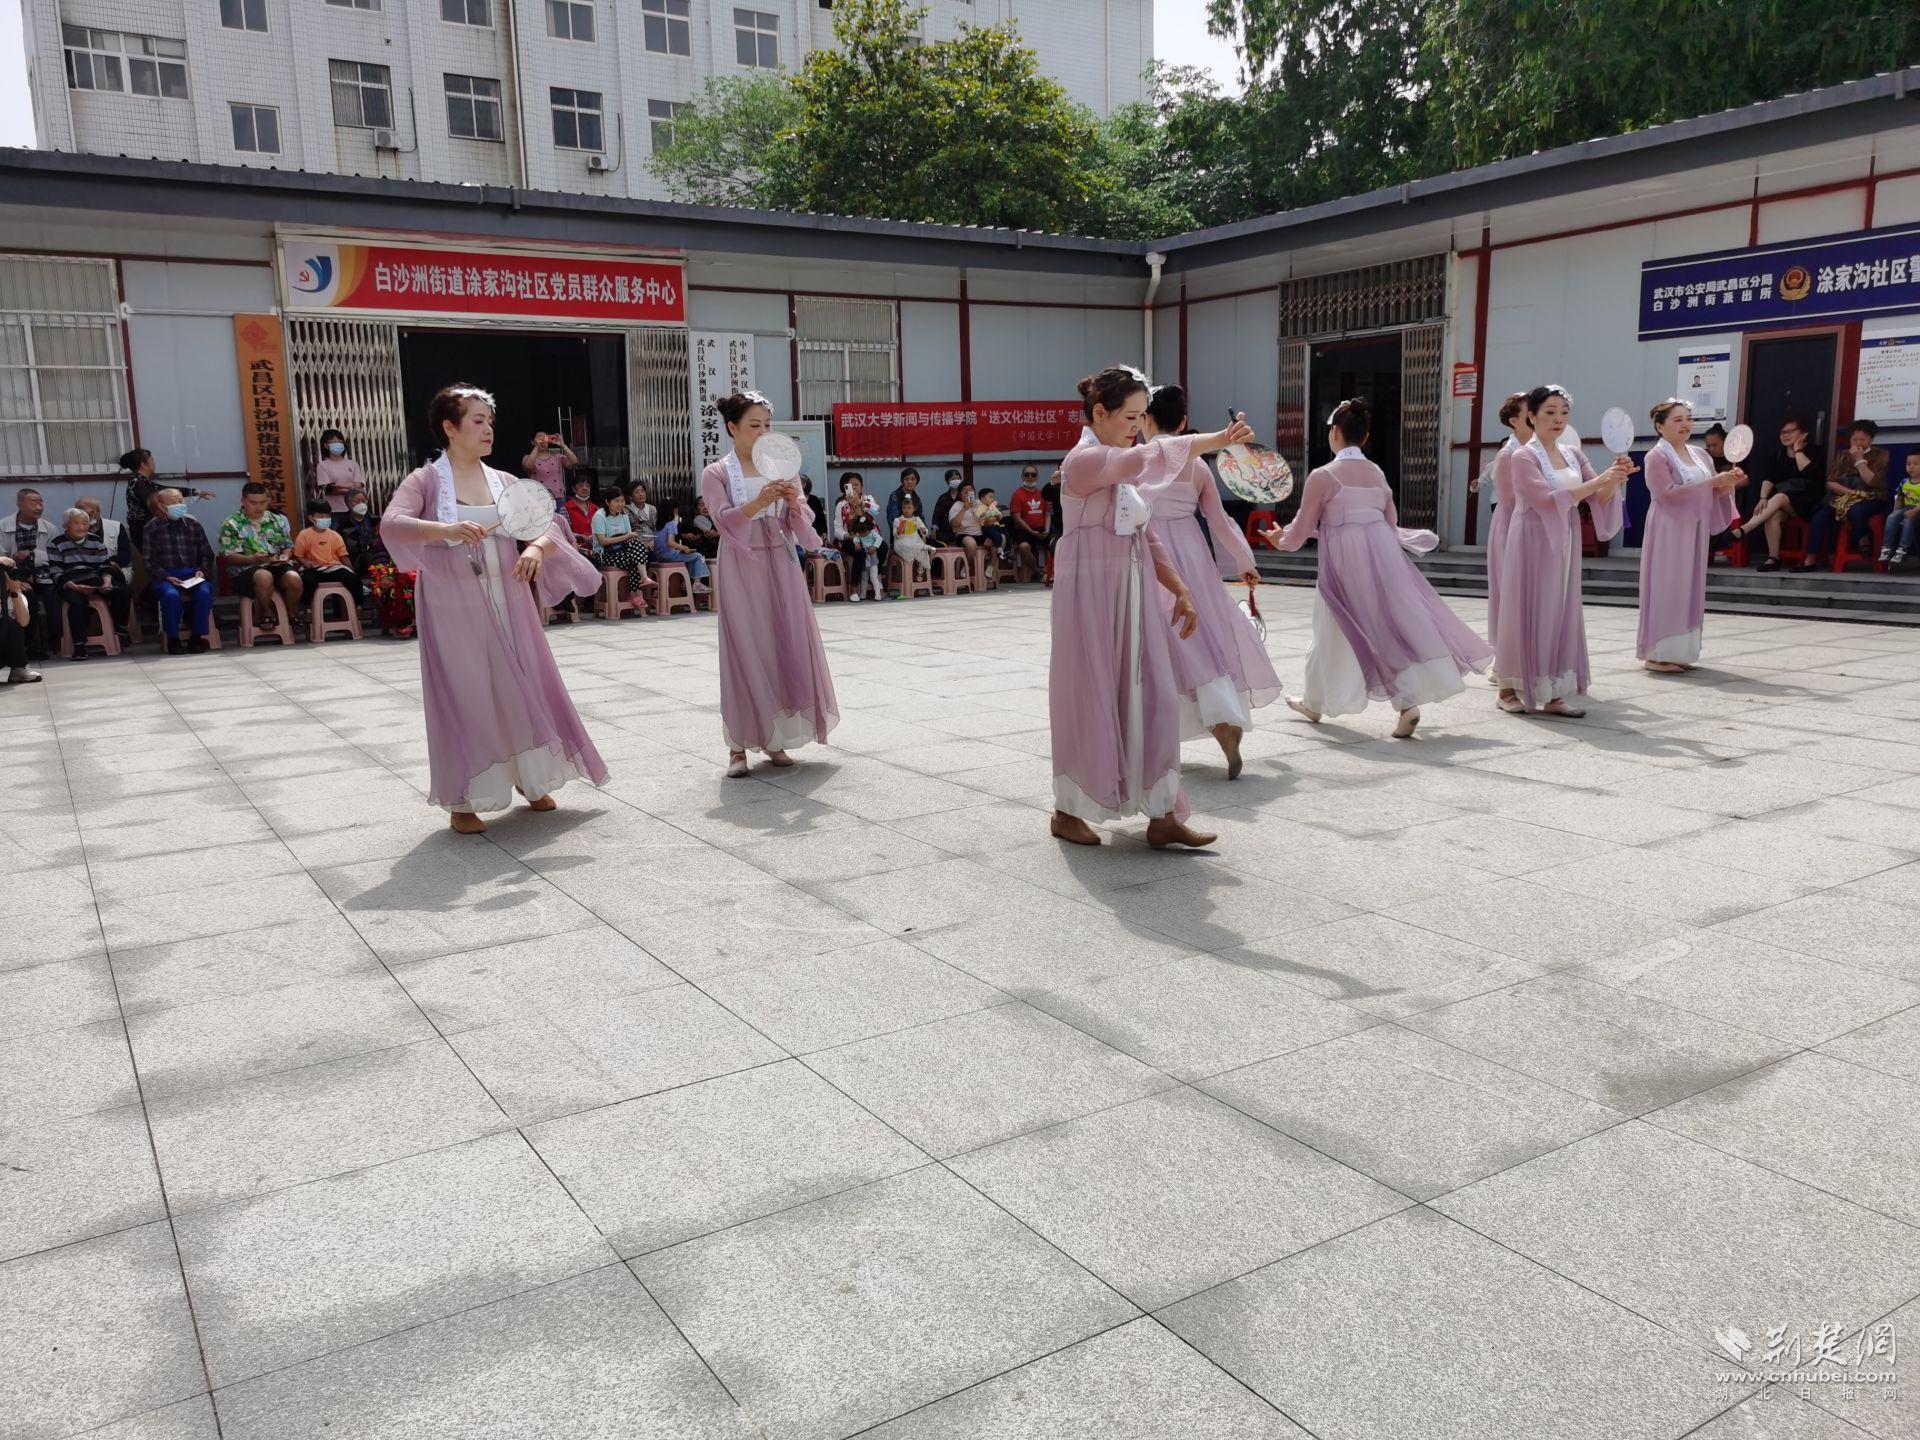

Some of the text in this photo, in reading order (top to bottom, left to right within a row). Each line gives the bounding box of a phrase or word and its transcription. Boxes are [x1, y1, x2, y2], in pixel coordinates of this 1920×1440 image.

[375, 262, 677, 306] 白沙洲街道涂家沟社区党员群众服务中心
[1653, 273, 1773, 300] 武汉市公安局武昌区分局
[1653, 287, 1772, 312] 白沙洲街派出所
